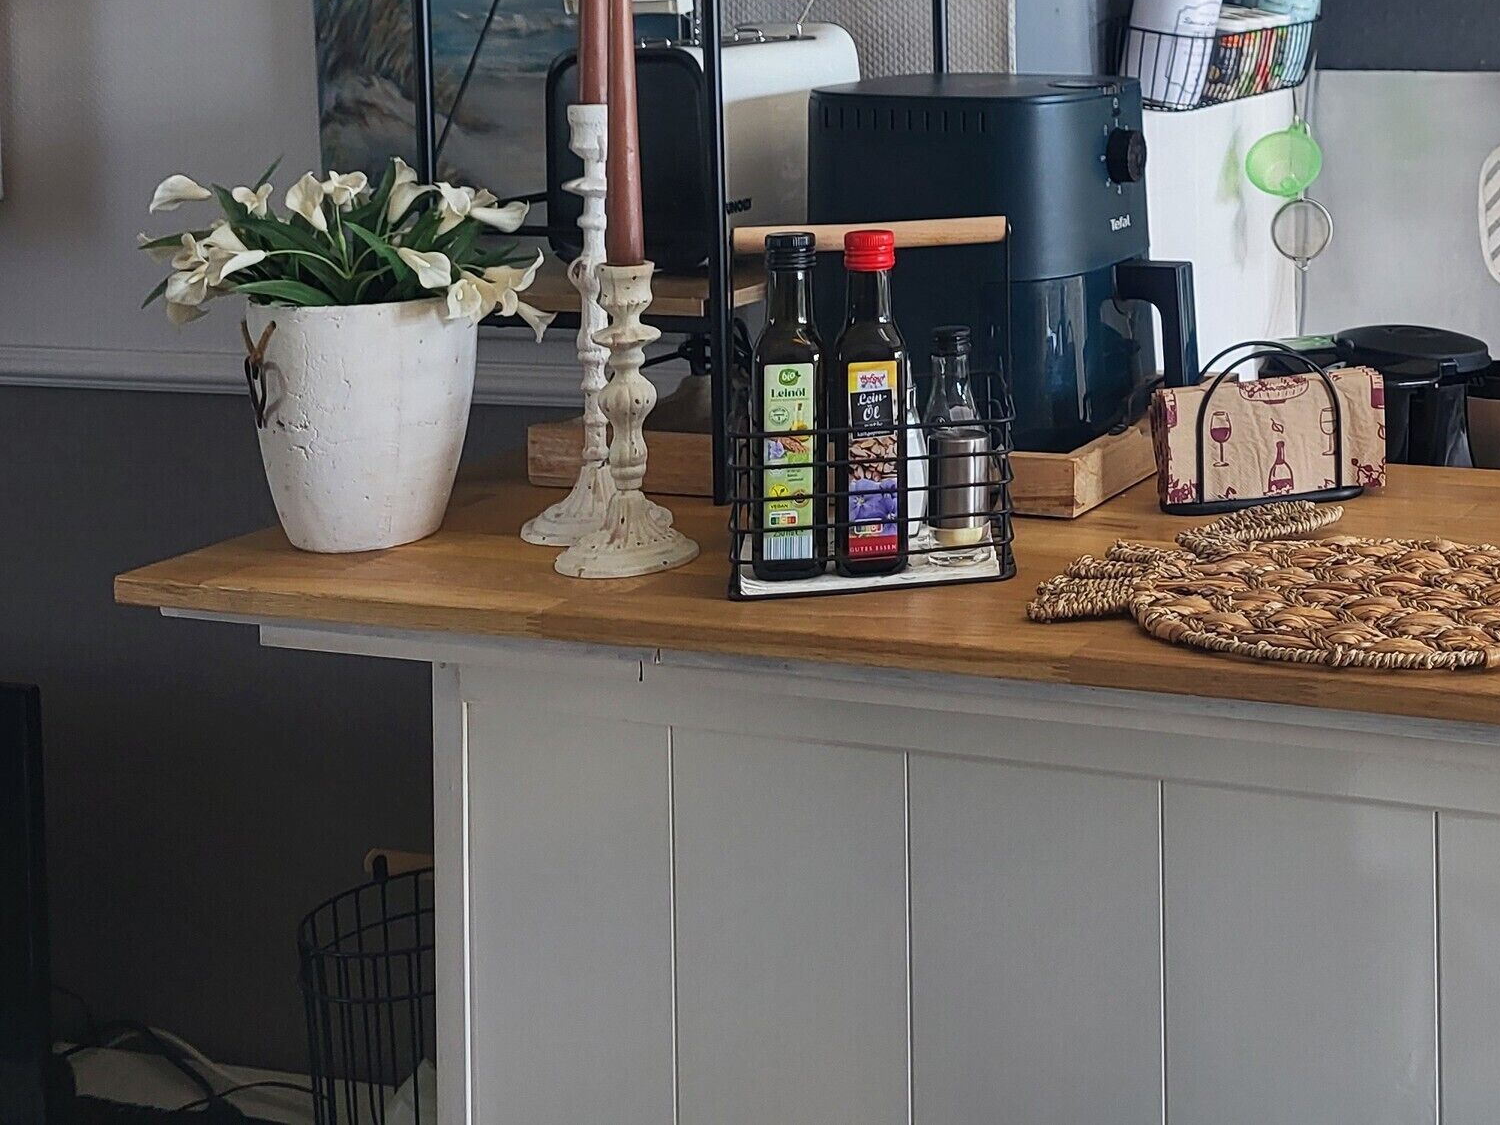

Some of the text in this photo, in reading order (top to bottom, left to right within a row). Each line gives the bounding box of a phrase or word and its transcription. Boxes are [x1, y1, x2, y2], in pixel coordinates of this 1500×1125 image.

[1109, 214, 1131, 232] Tefal
[781, 371, 796, 381] bio
[771, 388, 806, 398] Leinöl
[857, 392, 888, 406] Lein-
[863, 404, 881, 421] Öl
[850, 545, 873, 553] GUTES
